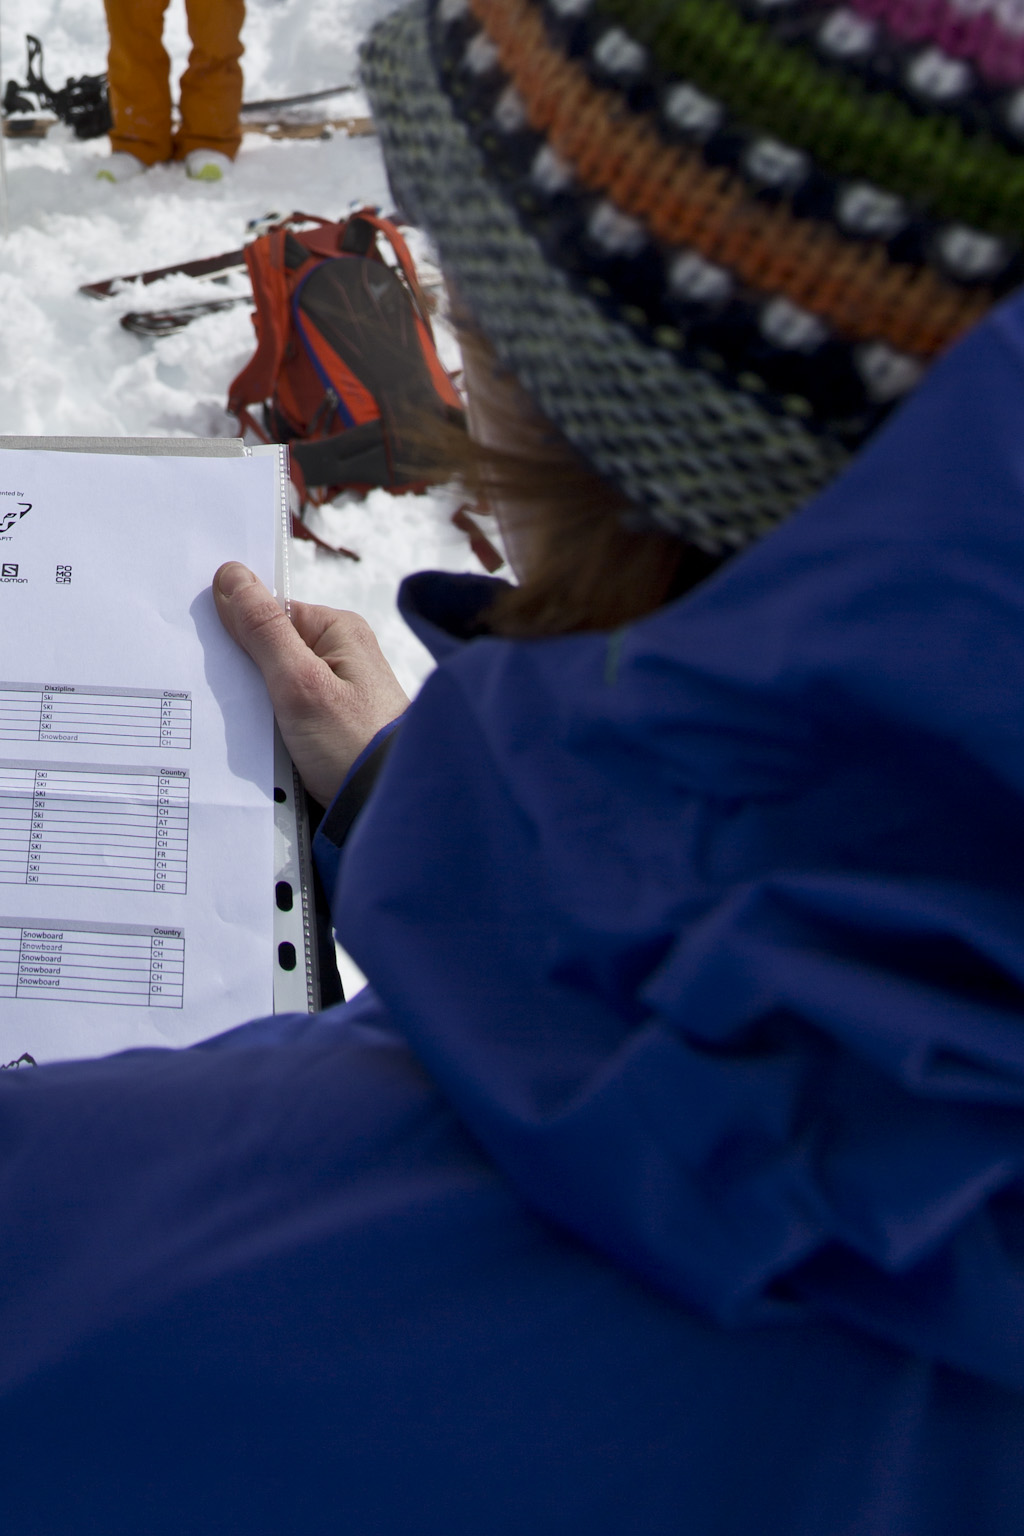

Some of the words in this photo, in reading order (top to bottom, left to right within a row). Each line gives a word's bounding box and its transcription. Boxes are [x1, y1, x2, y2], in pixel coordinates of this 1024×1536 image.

[44, 685, 75, 693] Diszipline
[163, 691, 189, 699] Country
[40, 733, 78, 741] Snowboard
[160, 768, 186, 777] Country
[23, 930, 64, 940] Snowboard
[153, 928, 181, 937] Country
[22, 942, 63, 951] Snowboard
[152, 950, 163, 958] CH
[21, 954, 62, 963] Snowboard
[20, 965, 61, 975] Snowboard
[19, 977, 60, 987] Snowboard
[151, 985, 162, 993] CH
